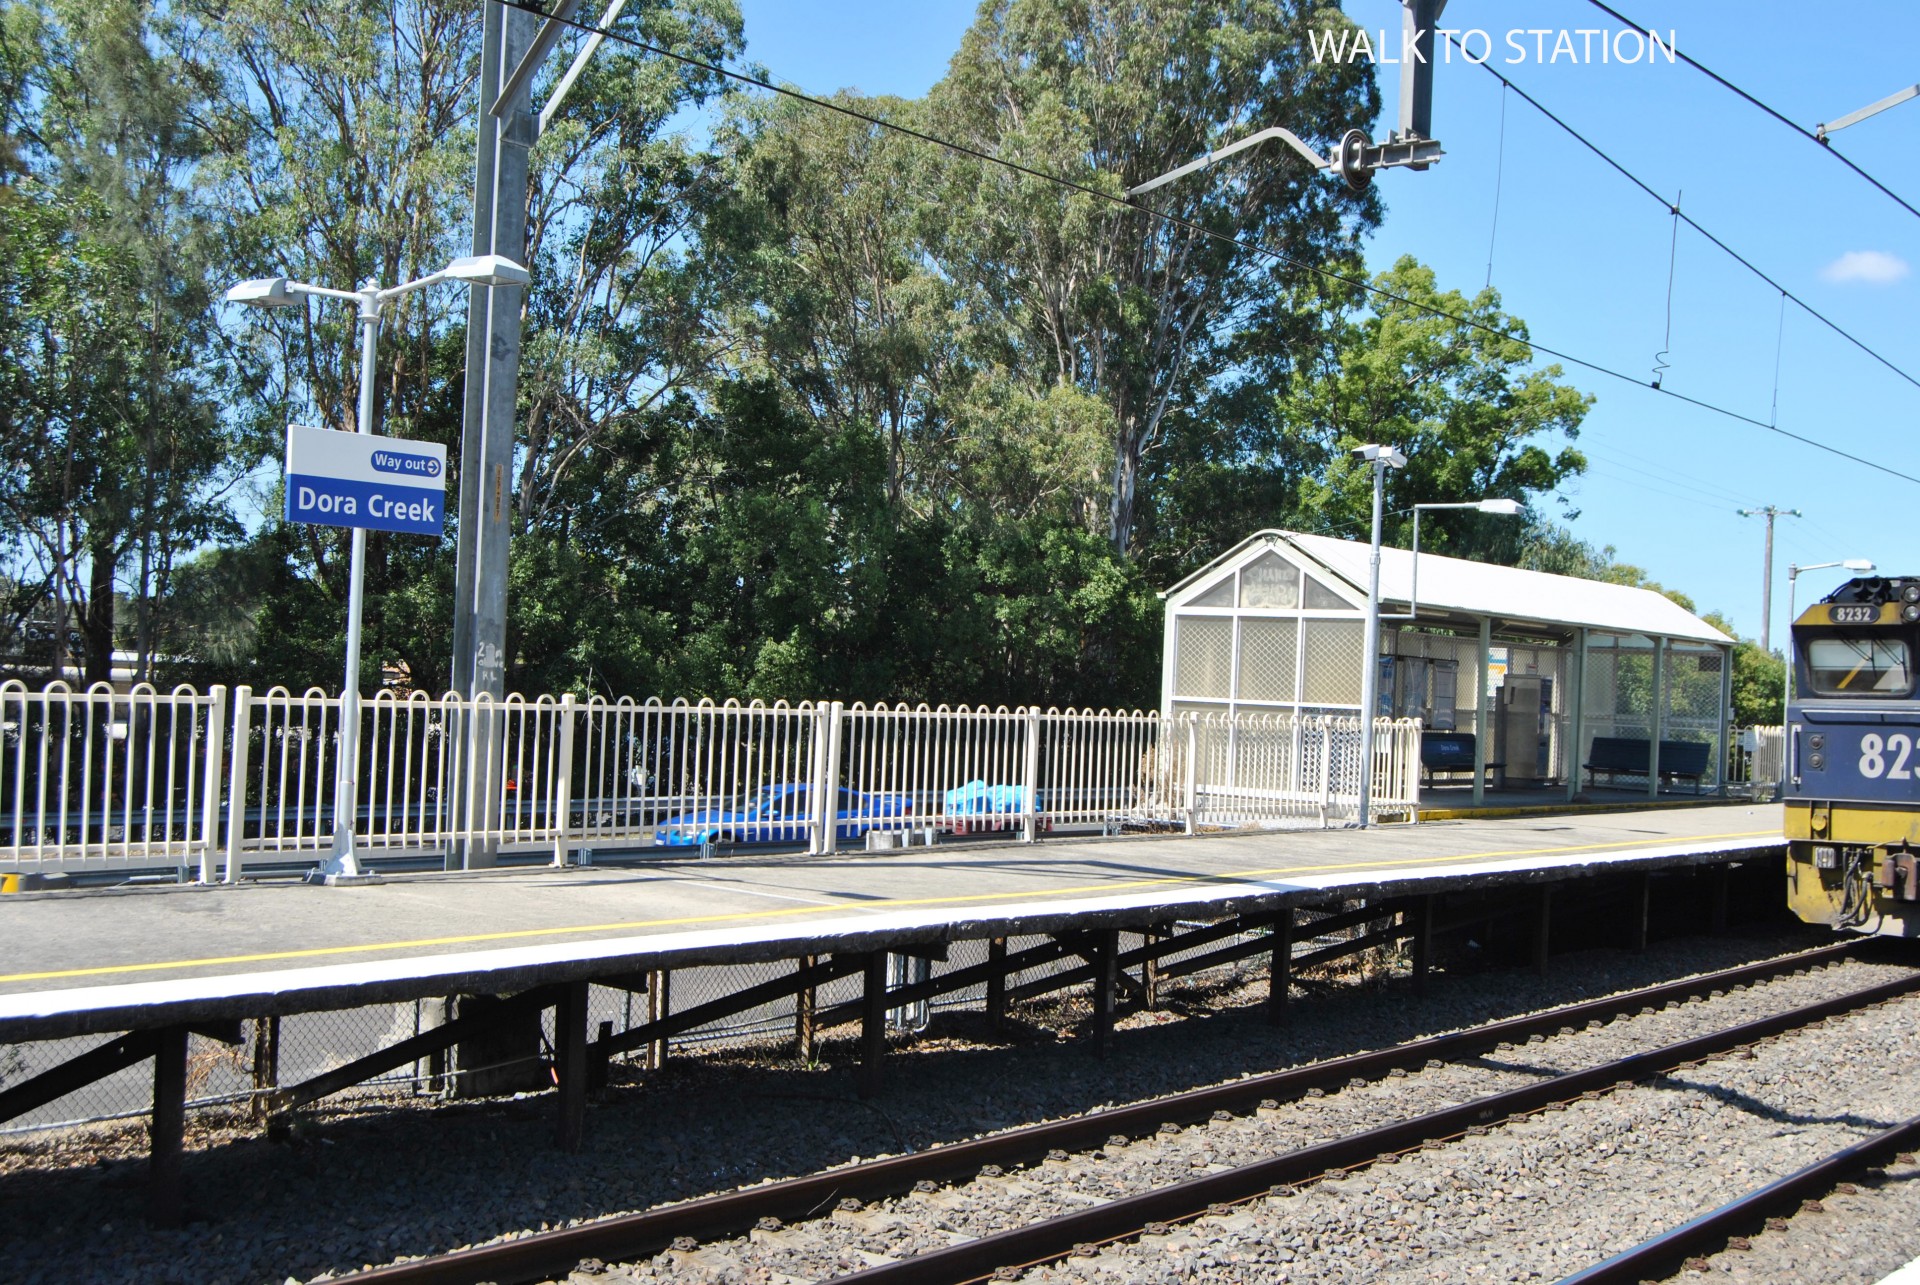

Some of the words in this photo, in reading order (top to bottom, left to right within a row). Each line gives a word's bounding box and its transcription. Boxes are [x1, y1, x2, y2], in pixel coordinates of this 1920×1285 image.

[375, 453, 401, 471] Way
[405, 460, 426, 471] out
[298, 486, 356, 515] Dora
[368, 494, 435, 523] Creek
[1837, 607, 1871, 622] 8232
